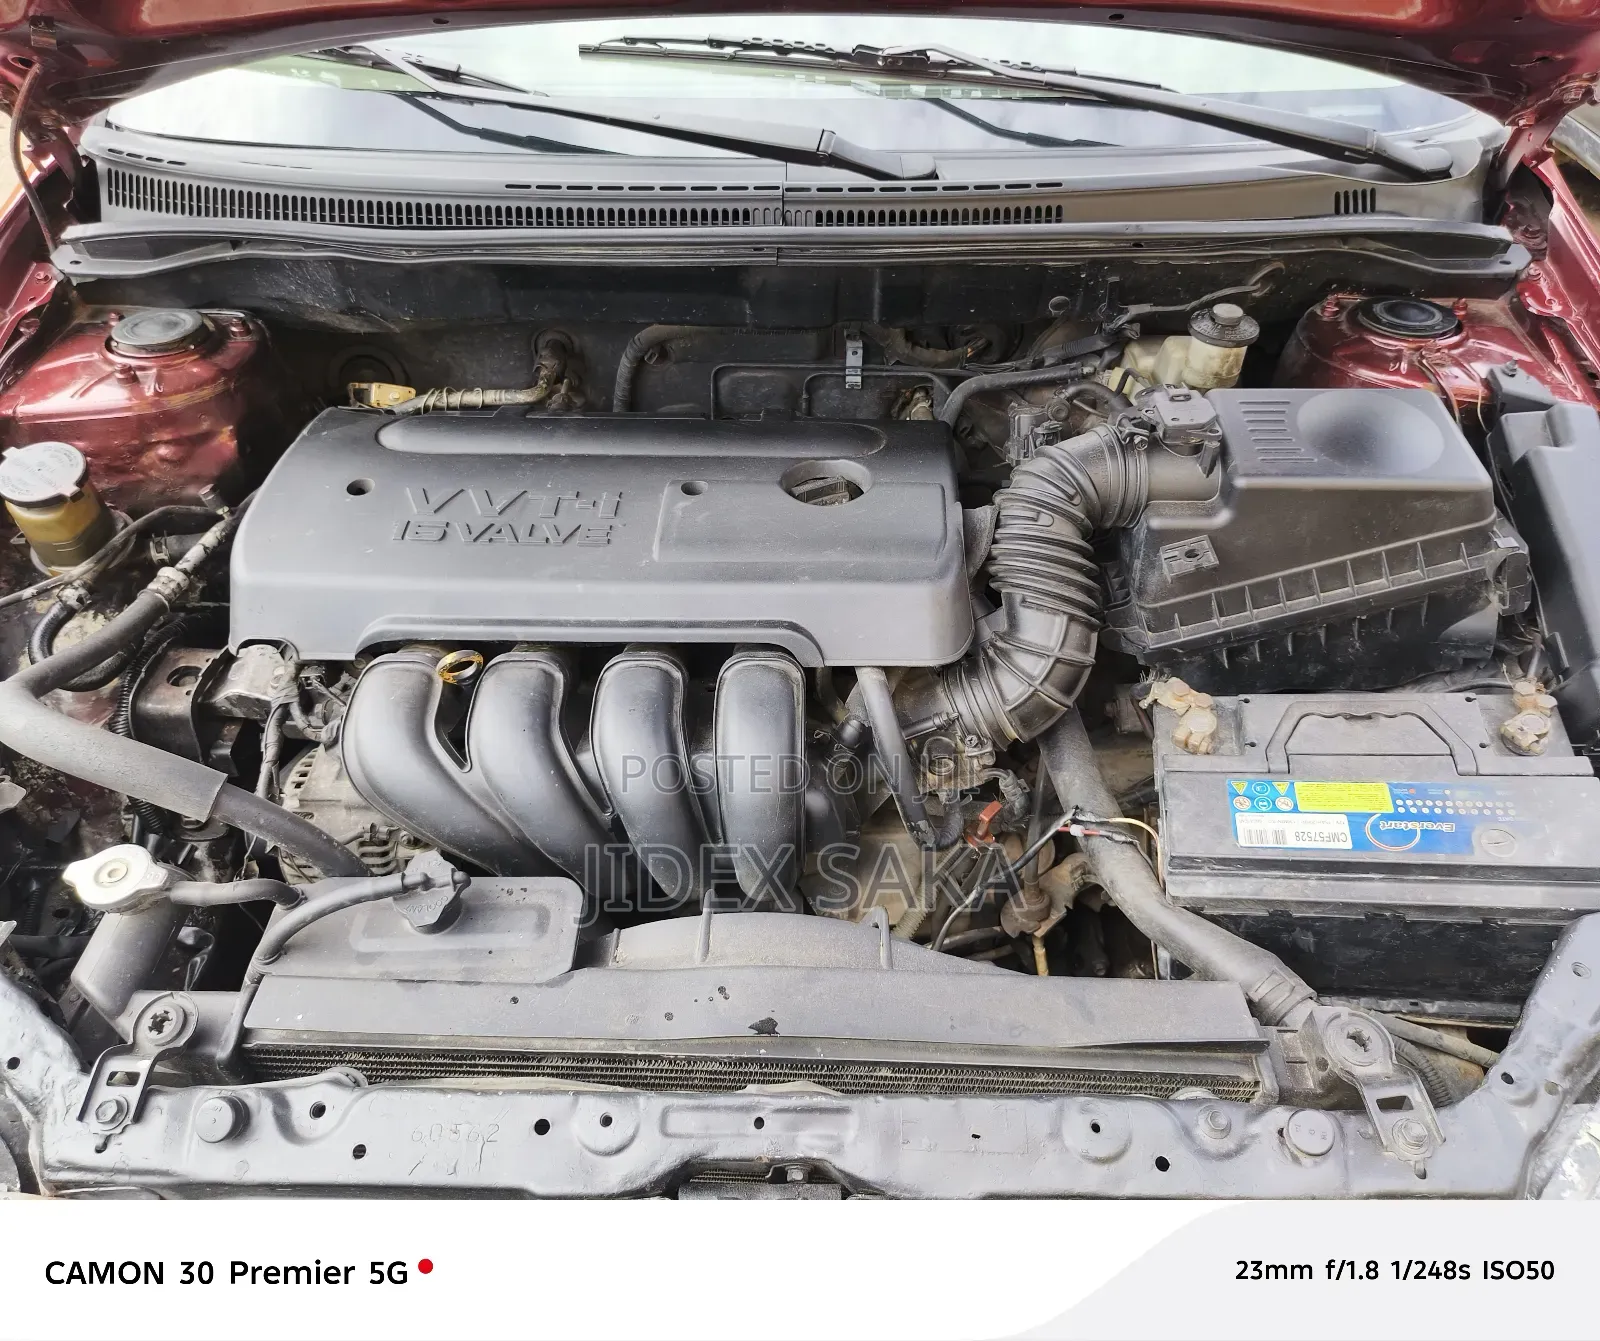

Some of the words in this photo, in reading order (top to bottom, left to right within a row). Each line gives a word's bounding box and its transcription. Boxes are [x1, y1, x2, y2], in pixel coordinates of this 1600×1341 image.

[393, 520, 450, 542] 16
[455, 522, 613, 546] VALVE
[1379, 820, 1455, 833] Everstart
[1294, 830, 1348, 843] CMF57528
